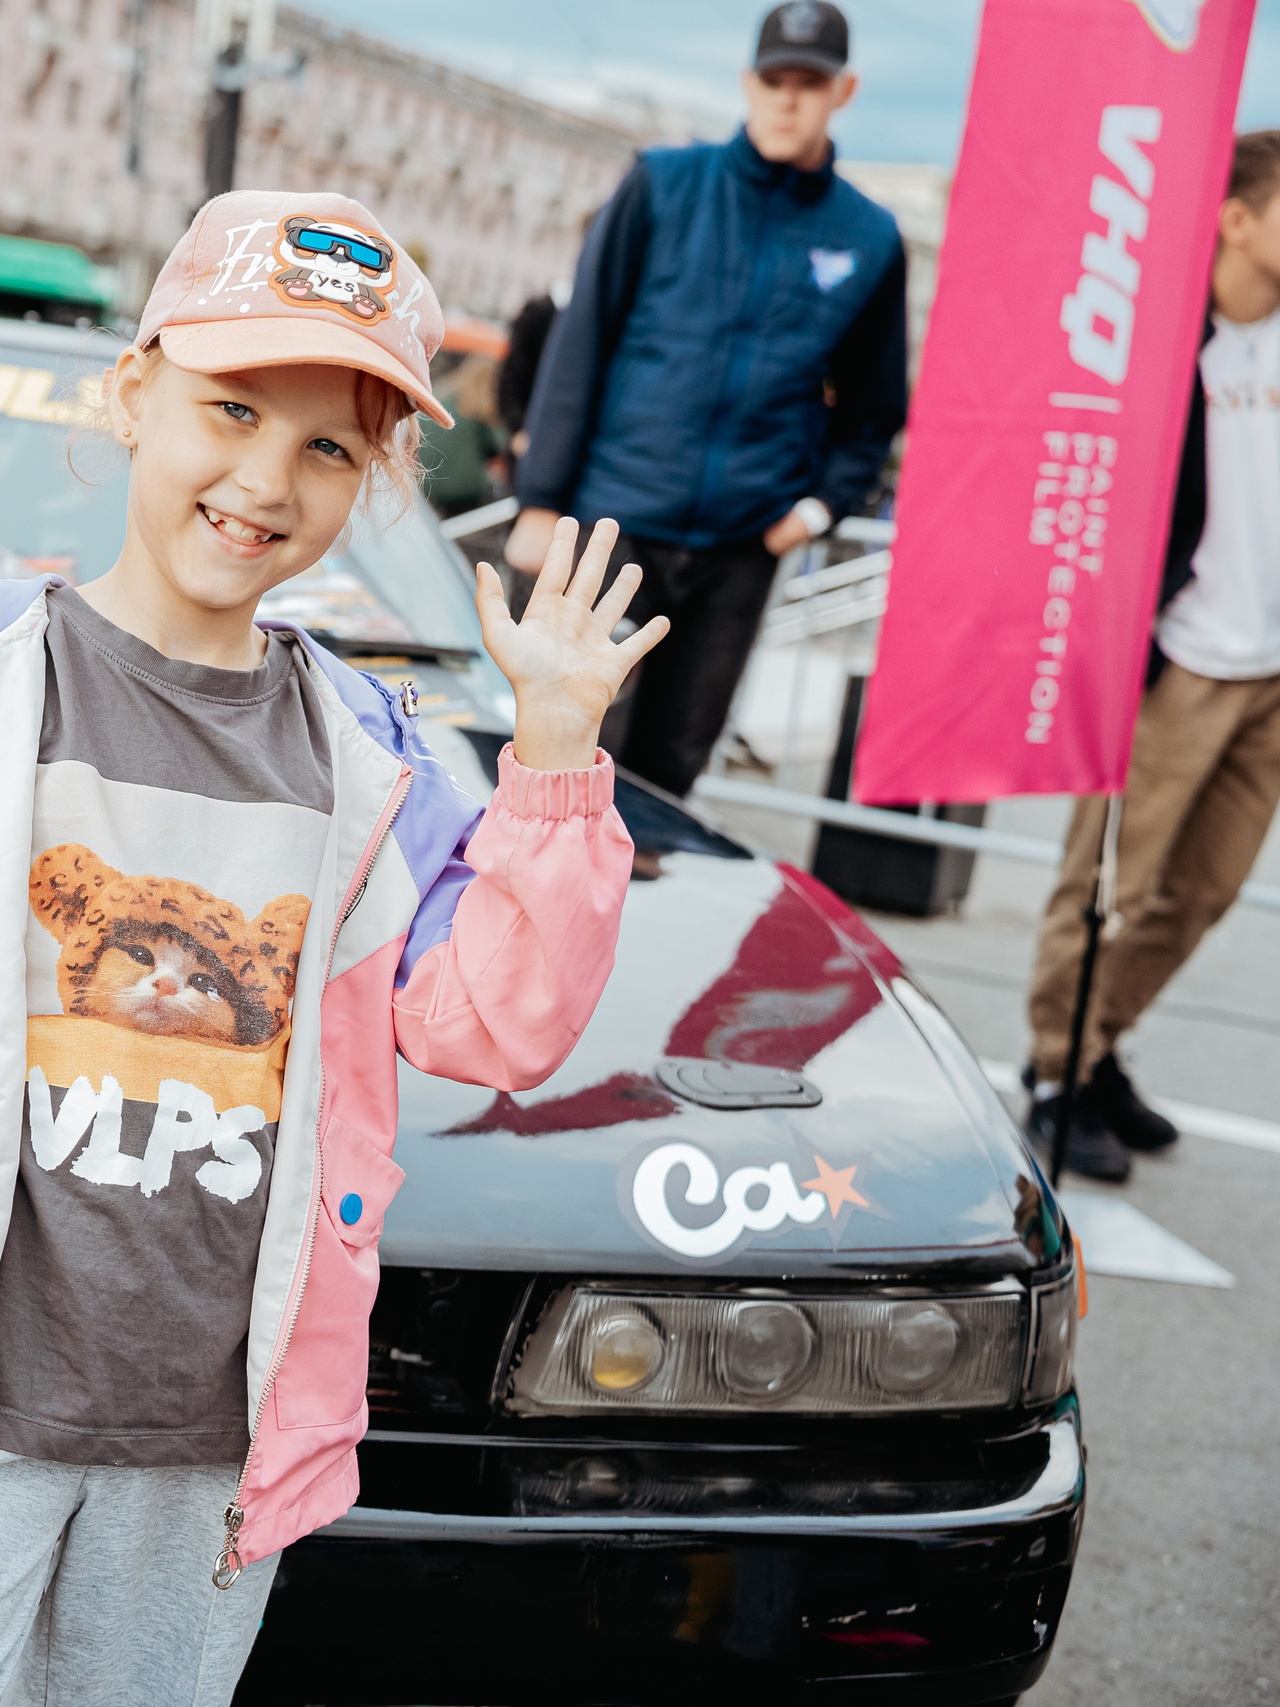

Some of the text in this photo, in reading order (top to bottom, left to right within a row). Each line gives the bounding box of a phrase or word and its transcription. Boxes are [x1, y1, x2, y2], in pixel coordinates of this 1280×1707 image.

[316, 273, 356, 293] yes
[1059, 104, 1163, 386] VHQ
[1027, 430, 1071, 546] FILM
[1077, 434, 1119, 580] PAINT
[1024, 431, 1097, 745] PROTECTION
[28, 1064, 267, 1205] VLPS
